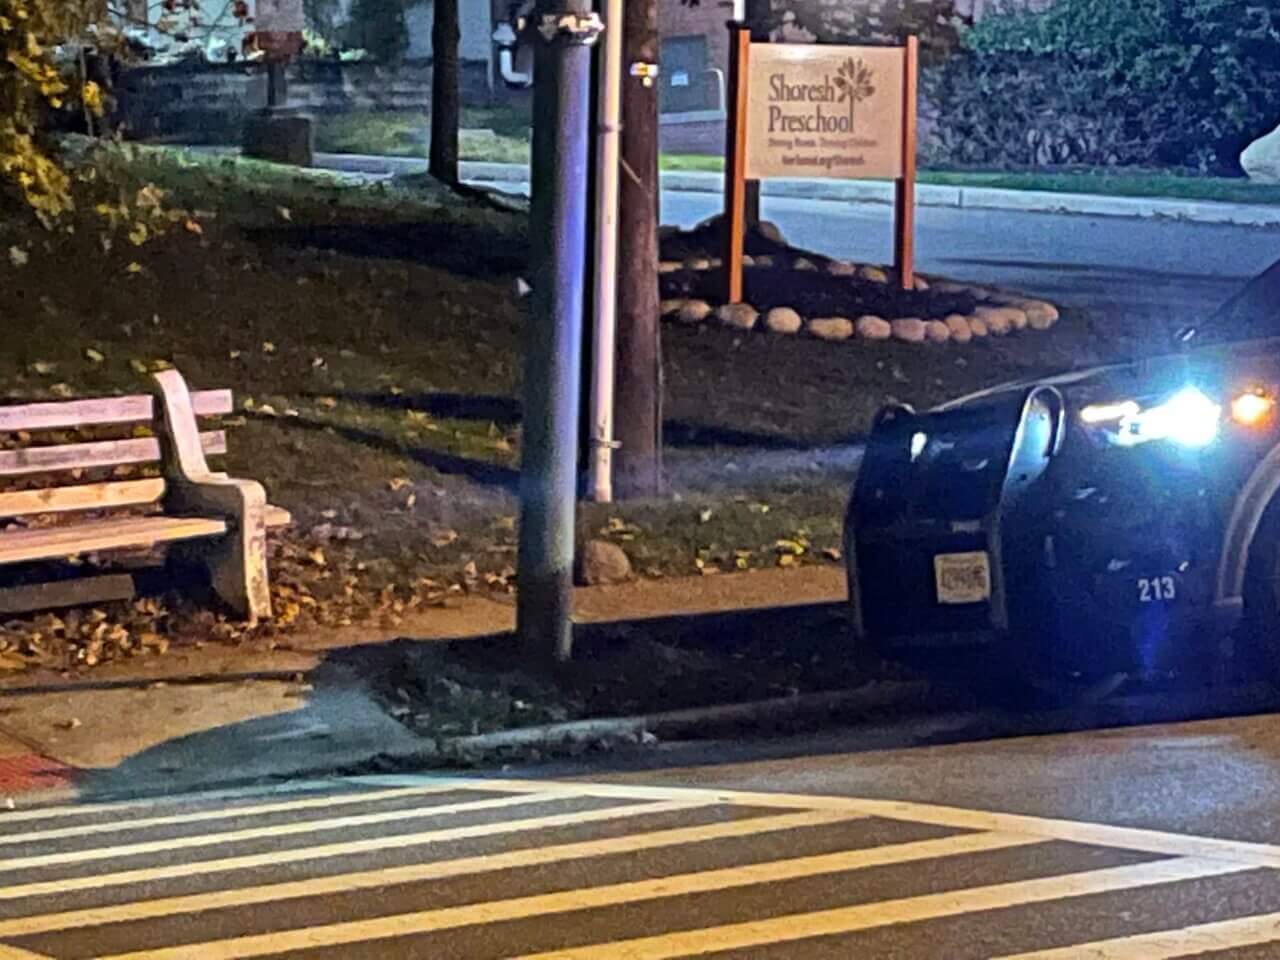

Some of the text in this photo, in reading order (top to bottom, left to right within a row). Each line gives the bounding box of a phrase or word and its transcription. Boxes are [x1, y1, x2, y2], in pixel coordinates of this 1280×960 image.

[768, 73, 835, 102] Shoresh
[768, 105, 854, 133] Preschool
[1136, 576, 1176, 602] 213
